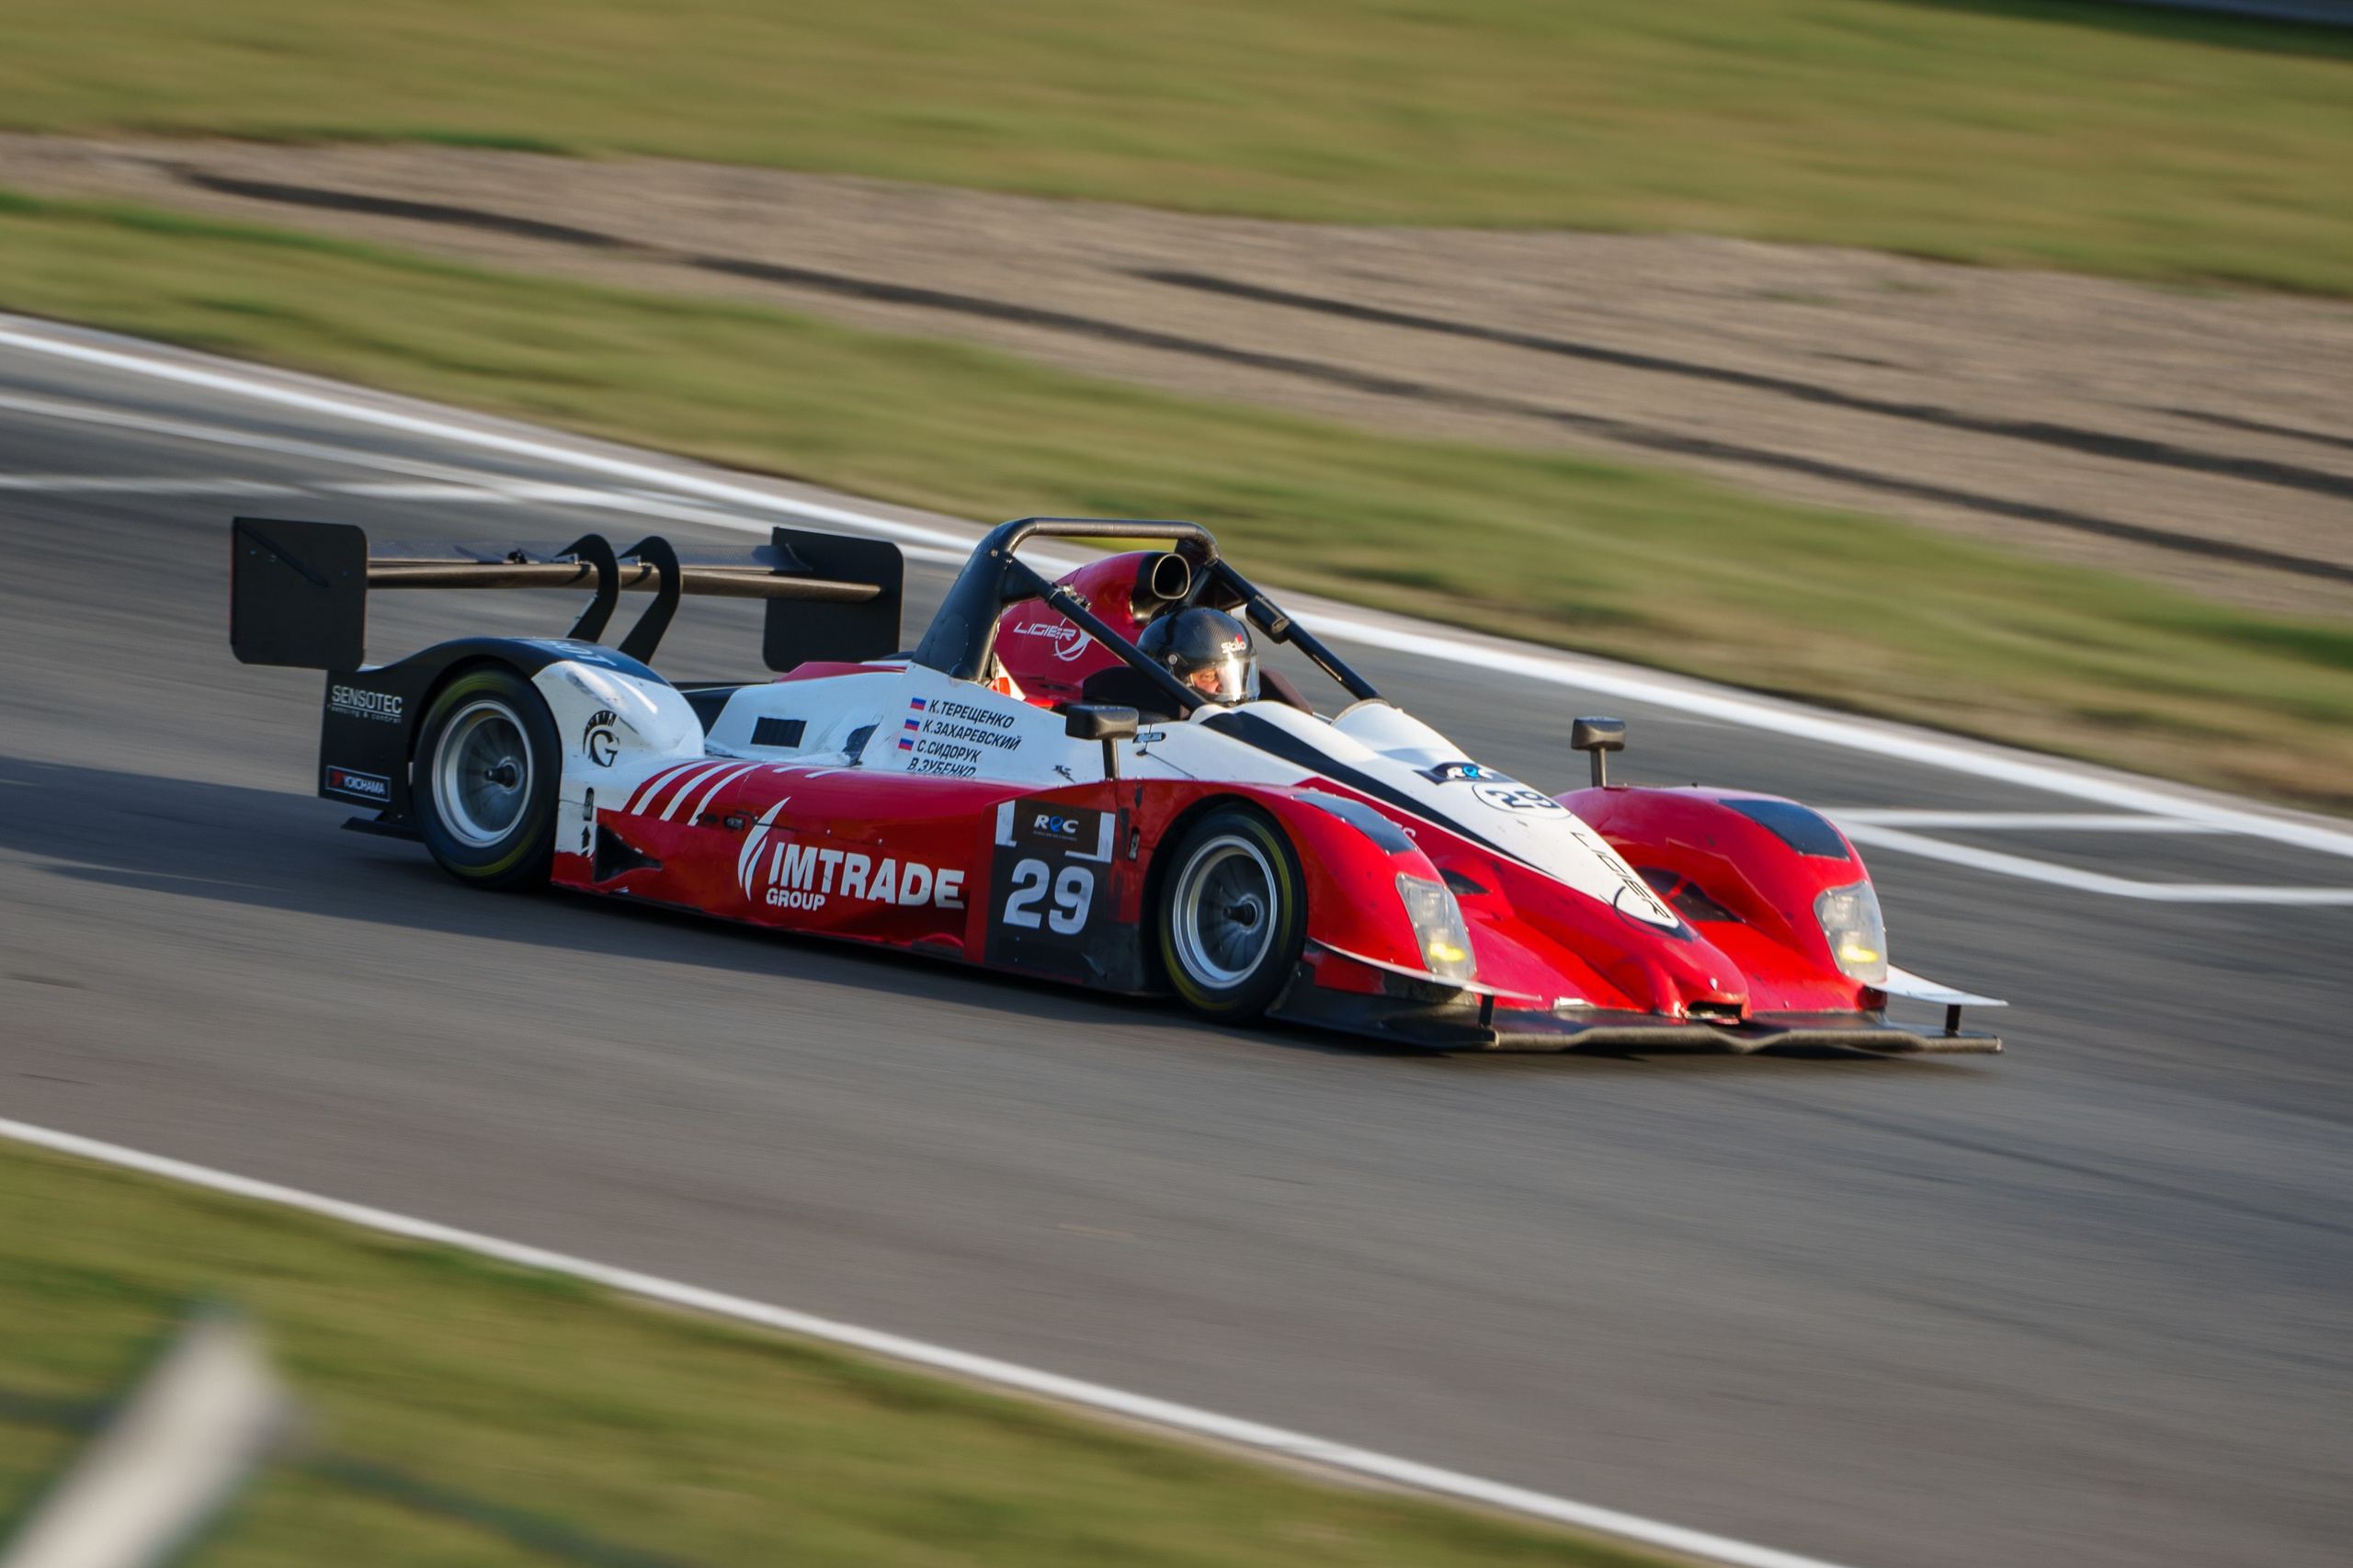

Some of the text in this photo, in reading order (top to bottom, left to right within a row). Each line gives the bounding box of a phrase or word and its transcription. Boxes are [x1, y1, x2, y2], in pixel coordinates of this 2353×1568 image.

[1014, 621, 1076, 641] LIGIER
[331, 685, 403, 714] SENSOTEC
[928, 699, 1015, 729] К.ТЕРЕЩЕНКО
[922, 719, 1022, 751] К.ЗАХАРЕВСКИЙ
[916, 739, 983, 763] С.СИДОРУК
[343, 775, 386, 795] YOKOHAMA
[1484, 790, 1562, 809] 29
[768, 842, 965, 910] IMTRADE
[766, 888, 825, 911] GROUP
[1003, 858, 1095, 936] 29
